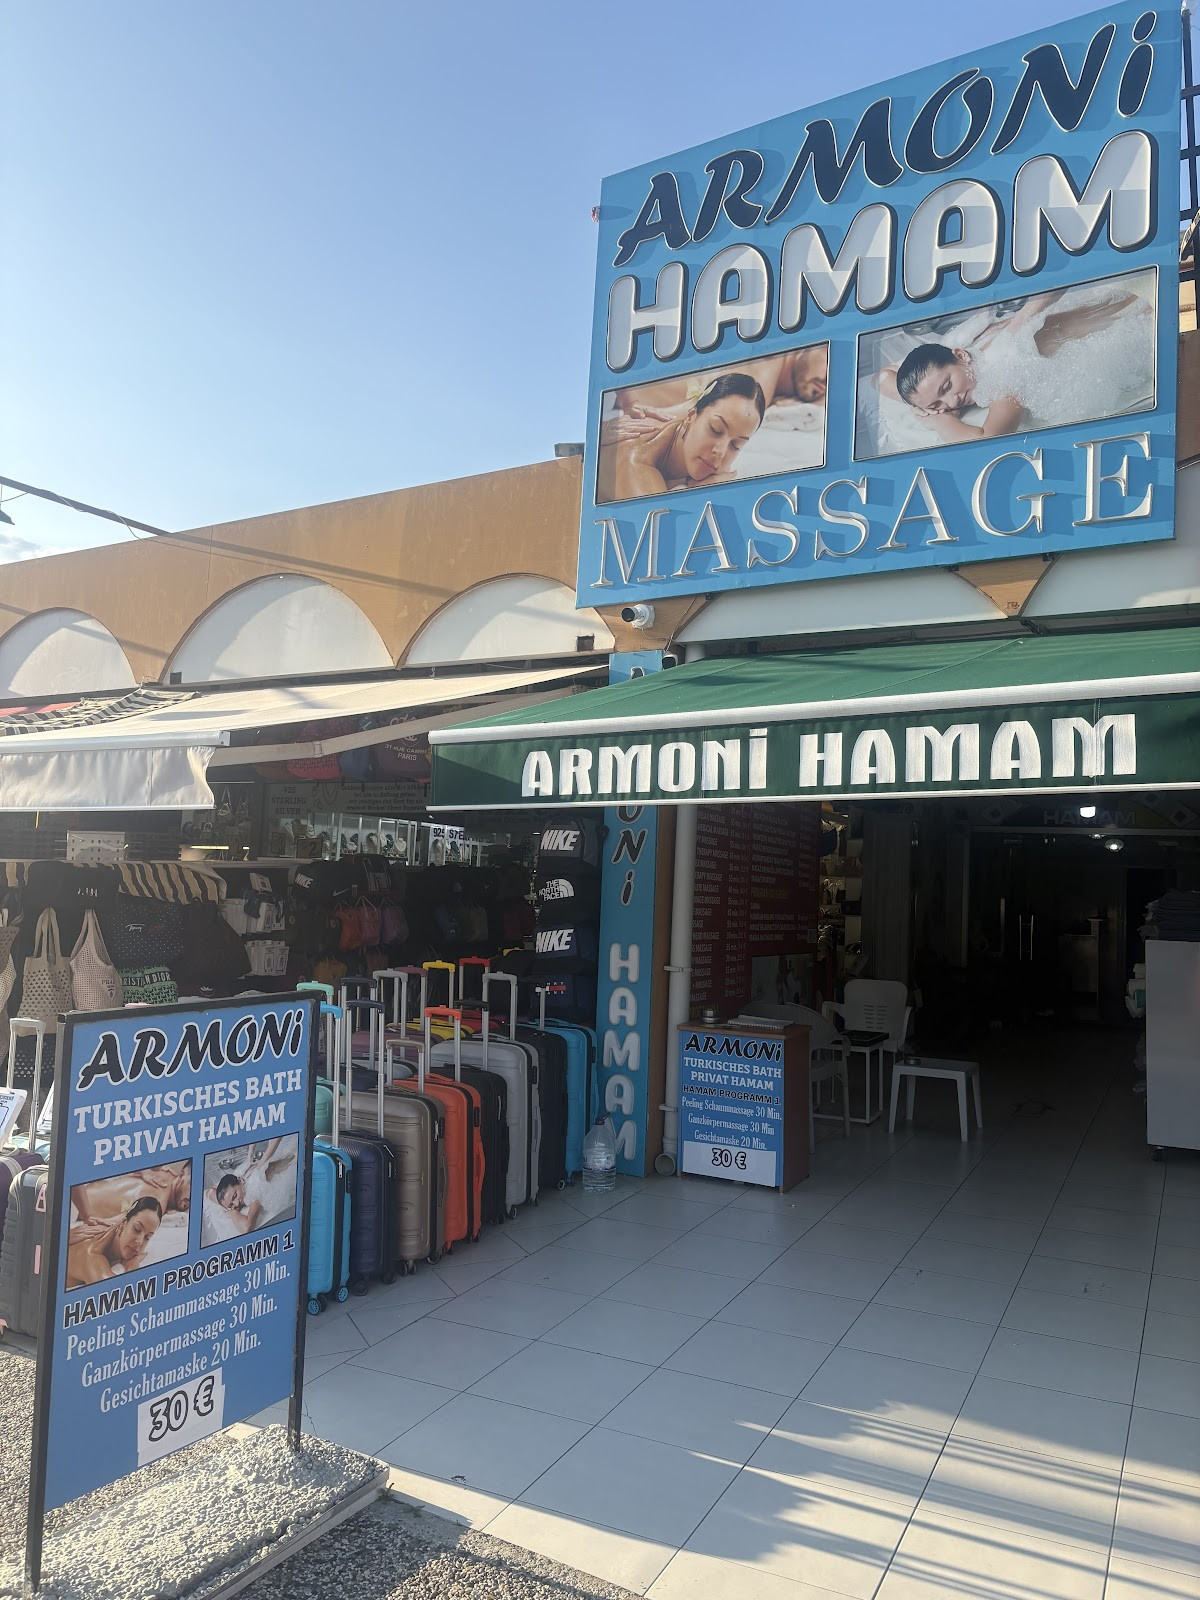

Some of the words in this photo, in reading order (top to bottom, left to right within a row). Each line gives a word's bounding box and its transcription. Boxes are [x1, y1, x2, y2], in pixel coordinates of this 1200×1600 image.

[605, 129, 1154, 372] HAMAM
[590, 431, 1154, 589] MASSAGE
[397, 752, 417, 761] PARIS
[798, 713, 1138, 790] HAMAM
[283, 786, 296, 794] 925
[433, 827, 445, 838] 925
[540, 829, 581, 851] NIKE
[294, 873, 315, 889] NIKE
[538, 886, 560, 896] NORTH
[545, 880, 559, 888] THE
[543, 893, 562, 902] FACE
[535, 928, 574, 954] NIKE
[152, 971, 171, 983] DIOR
[602, 943, 641, 1165] HAMAM
[683, 1057, 751, 1075] TURKISCHES
[752, 1066, 782, 1079] BATH
[690, 1071, 729, 1085] PRIVAT
[730, 1077, 774, 1091] HAMAM
[74, 1081, 240, 1134] TURKISCHES
[245, 1069, 302, 1102] BATH
[682, 1084, 717, 1097] HAMAM
[718, 1089, 773, 1104] PROGRAMM
[681, 1097, 704, 1111] Peeling
[704, 1099, 755, 1118] Schaummassage
[754, 1106, 767, 1118] 30
[93, 1122, 193, 1166] PRIVAT
[198, 1102, 286, 1143] HAMAM
[749, 1120, 760, 1133] 30
[740, 1137, 751, 1148] 20
[711, 1147, 732, 1168] 30
[734, 1151, 748, 1170] €
[63, 1277, 158, 1331] HAMAM
[162, 1240, 280, 1297] PROGRAMM
[281, 1229, 296, 1254] 1
[67, 1325, 127, 1361] Peeling
[129, 1281, 242, 1339] Schaummassage
[243, 1266, 261, 1293] 30
[263, 1259, 292, 1286] Min.
[81, 1319, 227, 1388] Ganzkörpermassage
[229, 1300, 248, 1329] 30
[250, 1295, 279, 1321] Min.
[101, 1355, 208, 1415] Gesichtamaske
[210, 1336, 231, 1367] 20
[233, 1328, 262, 1358] Min.
[148, 1390, 189, 1442] 30
[193, 1375, 216, 1417] €
